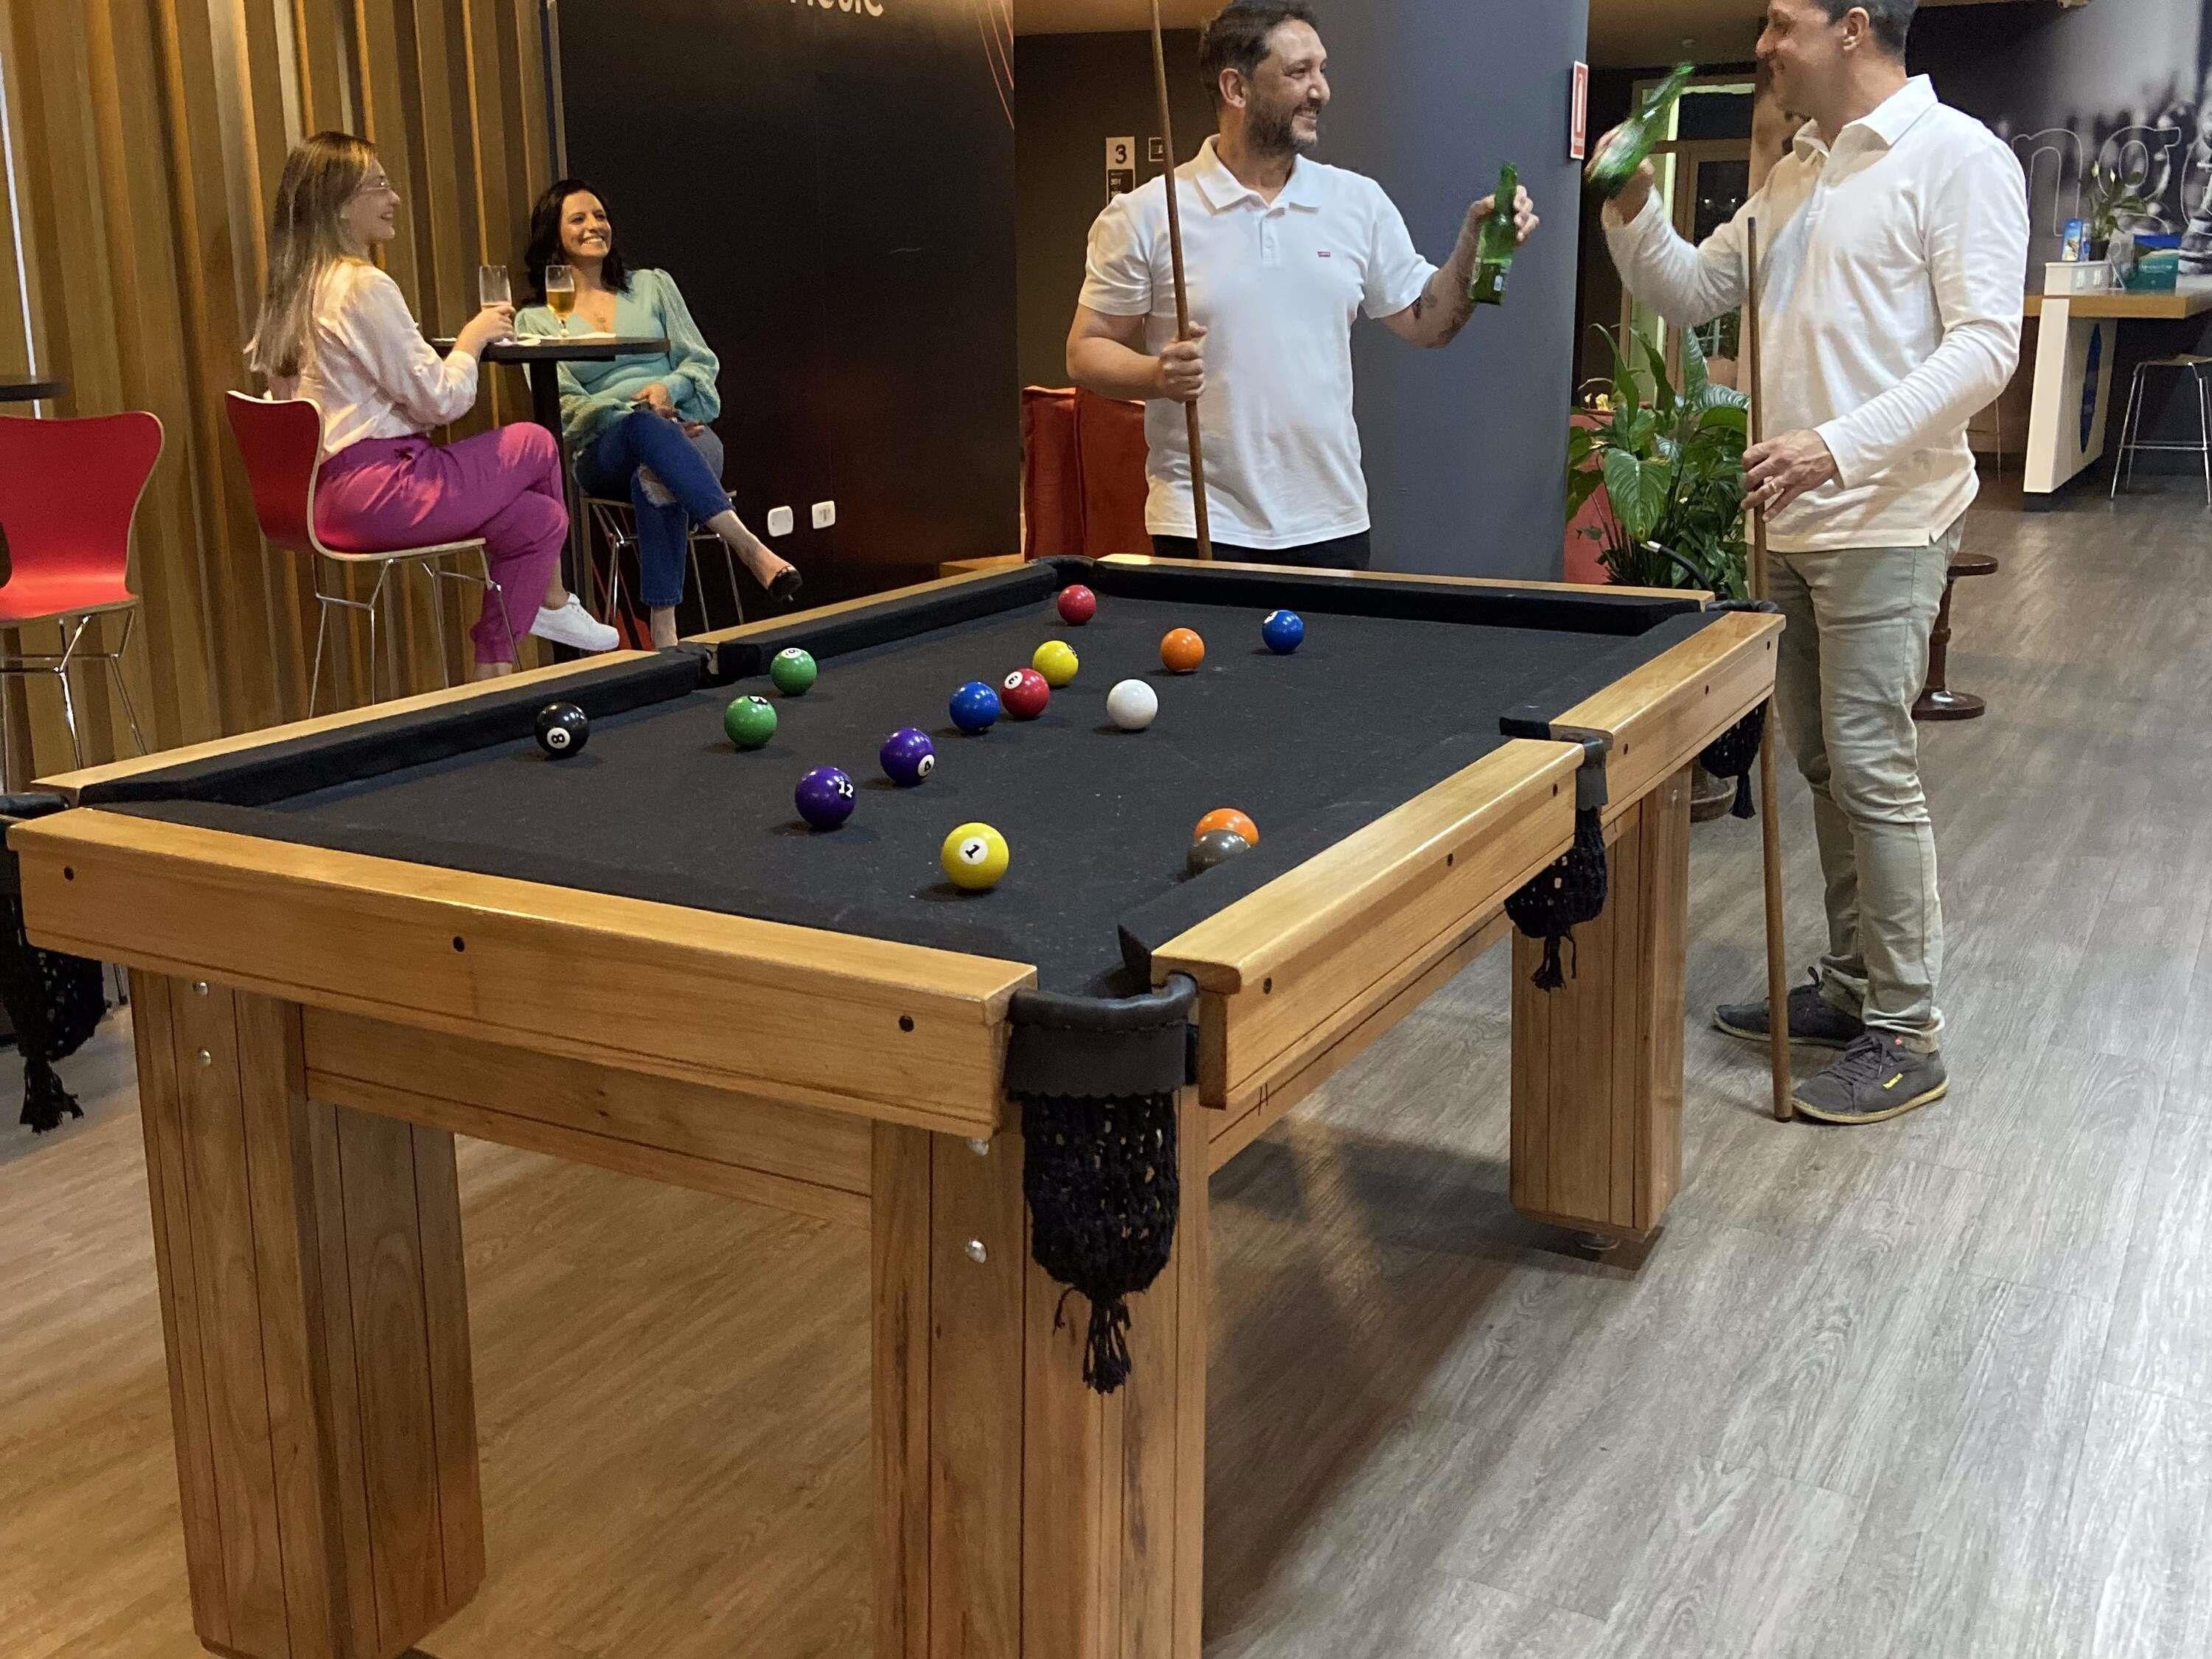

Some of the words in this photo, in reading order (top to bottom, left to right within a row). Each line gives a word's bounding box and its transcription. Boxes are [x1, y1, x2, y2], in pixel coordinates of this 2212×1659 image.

[1115, 144, 1127, 164] 3
[1008, 675, 1018, 684] 3
[551, 733, 566, 744] 8
[924, 760, 931, 772] 4
[838, 781, 854, 799] 12
[965, 844, 981, 859] 1
